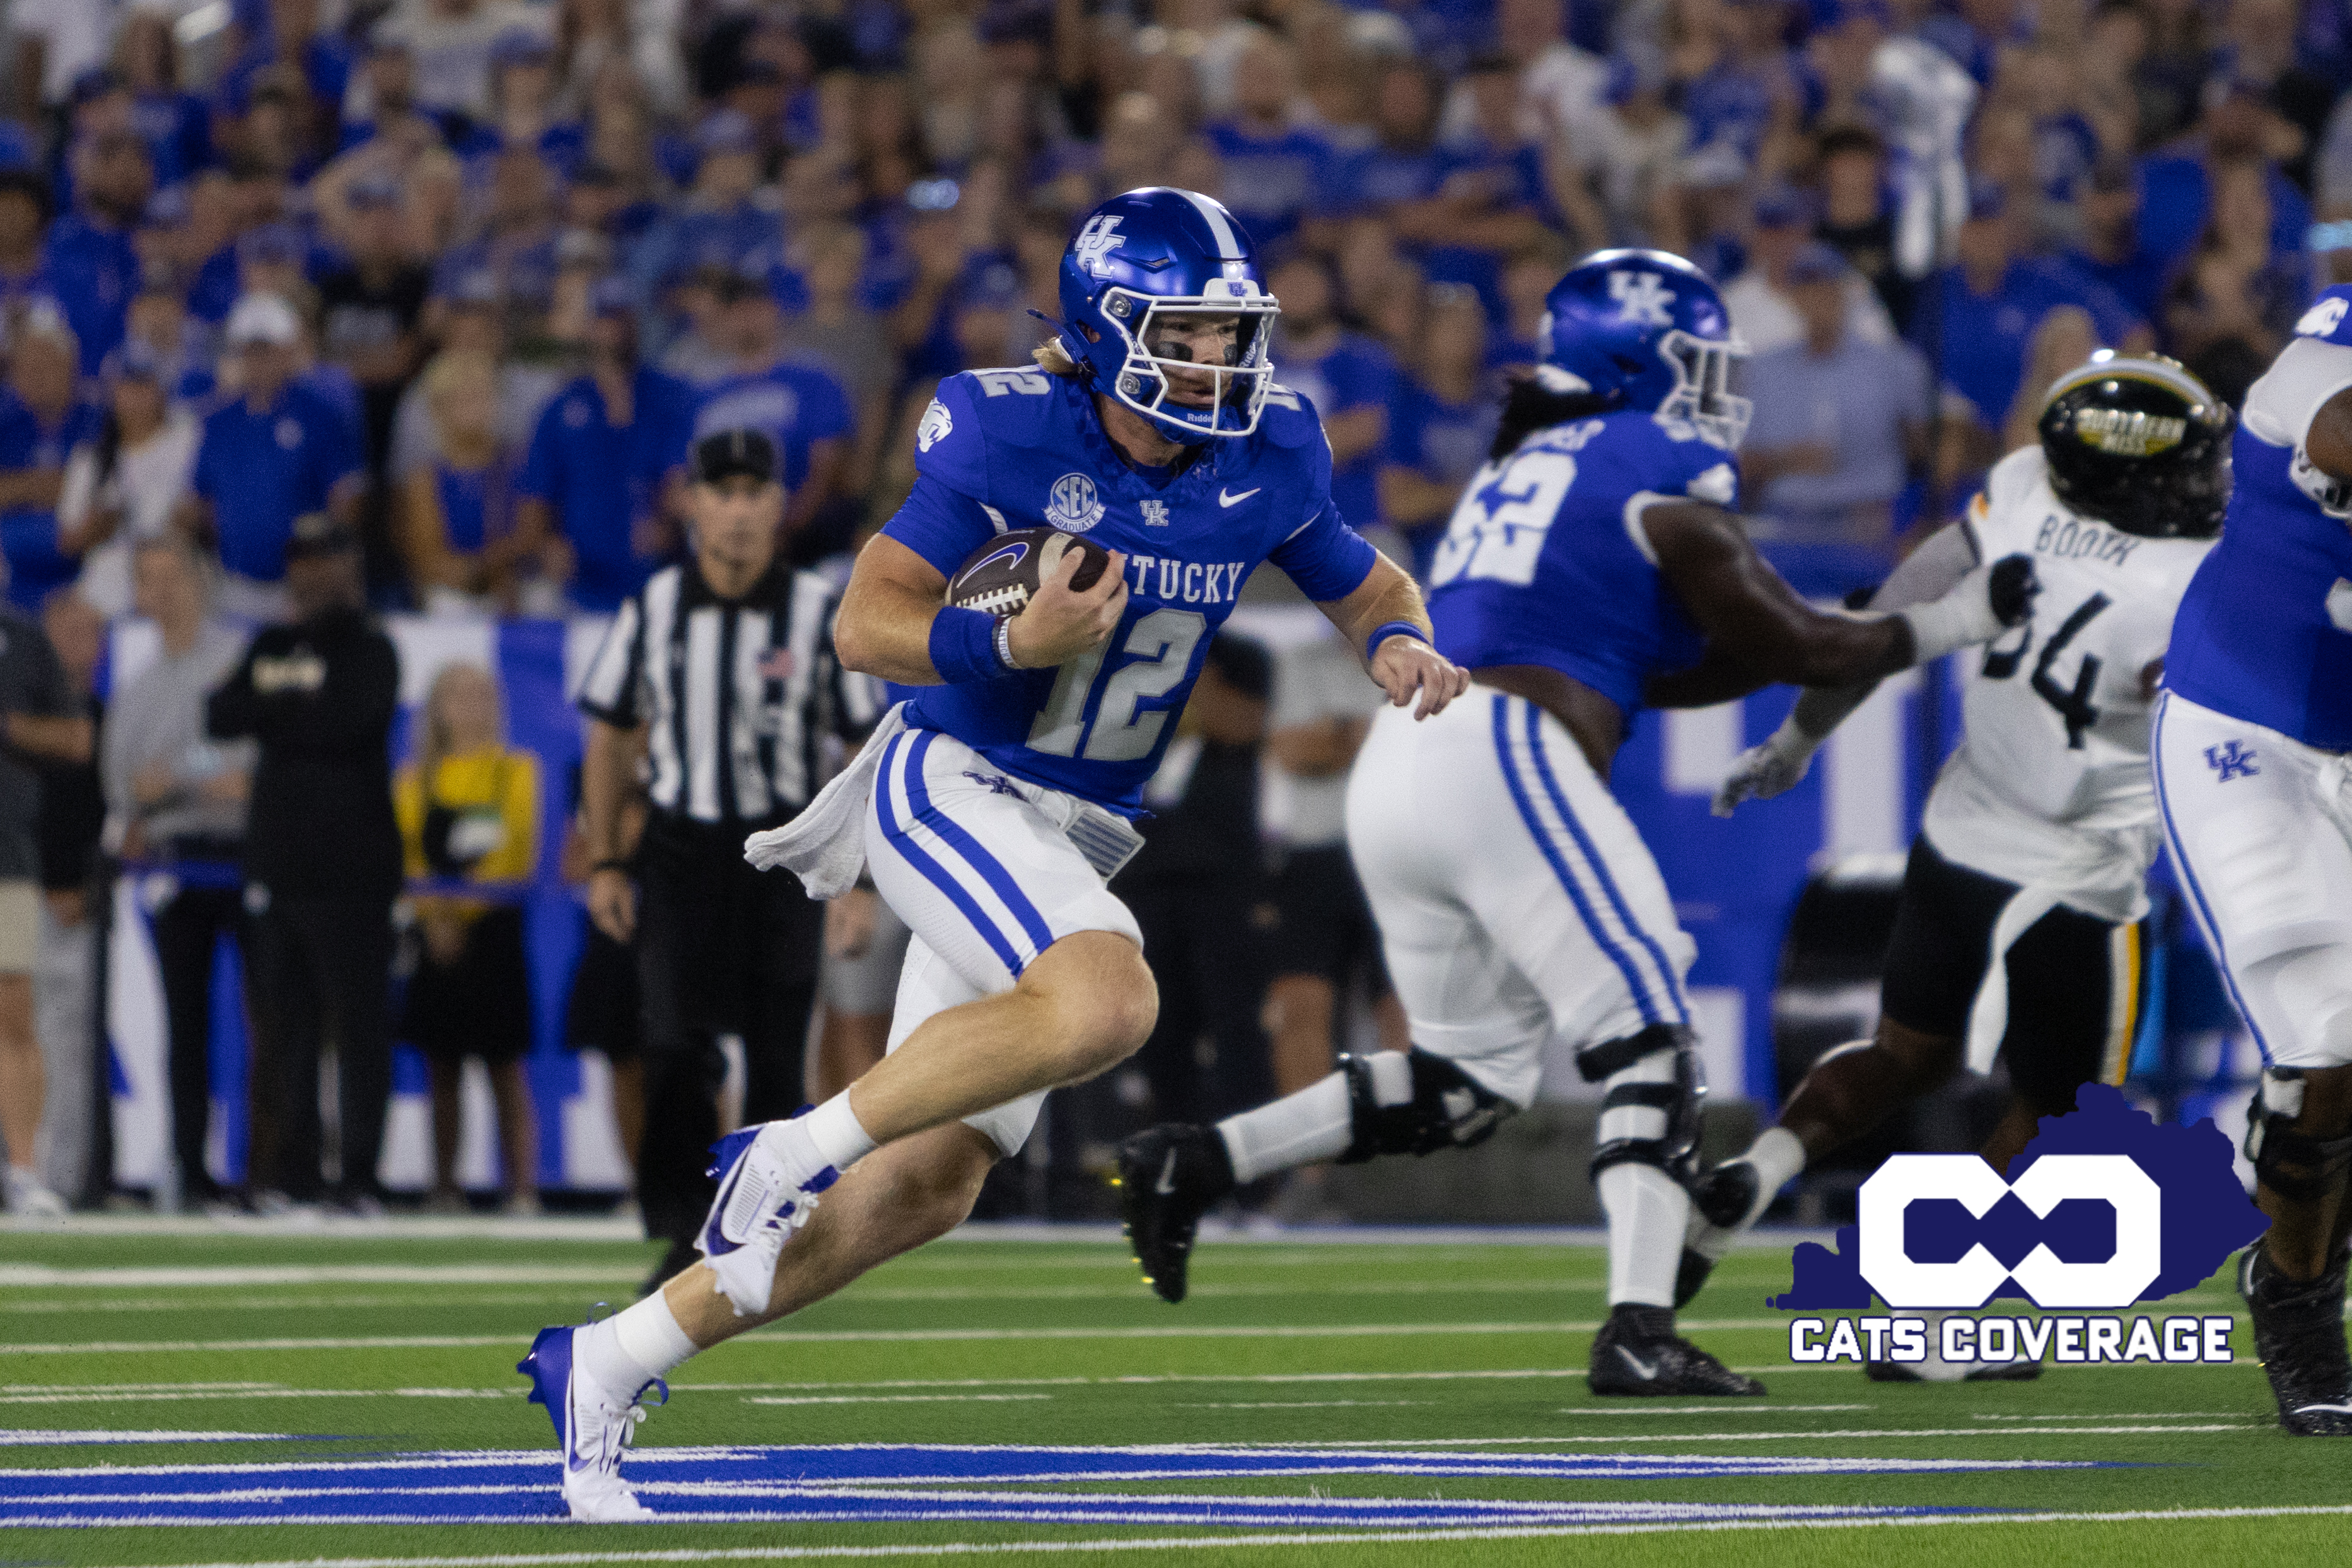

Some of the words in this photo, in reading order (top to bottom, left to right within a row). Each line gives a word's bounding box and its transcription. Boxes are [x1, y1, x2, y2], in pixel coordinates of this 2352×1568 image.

[1075, 215, 1127, 279] UK
[1187, 413, 1214, 423] Ridde
[1055, 477, 1093, 518] SEC
[1139, 500, 1169, 526] UK
[1050, 513, 1100, 531] GRADUATE
[1121, 552, 1245, 603] TUCKY
[1025, 608, 1208, 761] 12
[2203, 738, 2261, 783] UK
